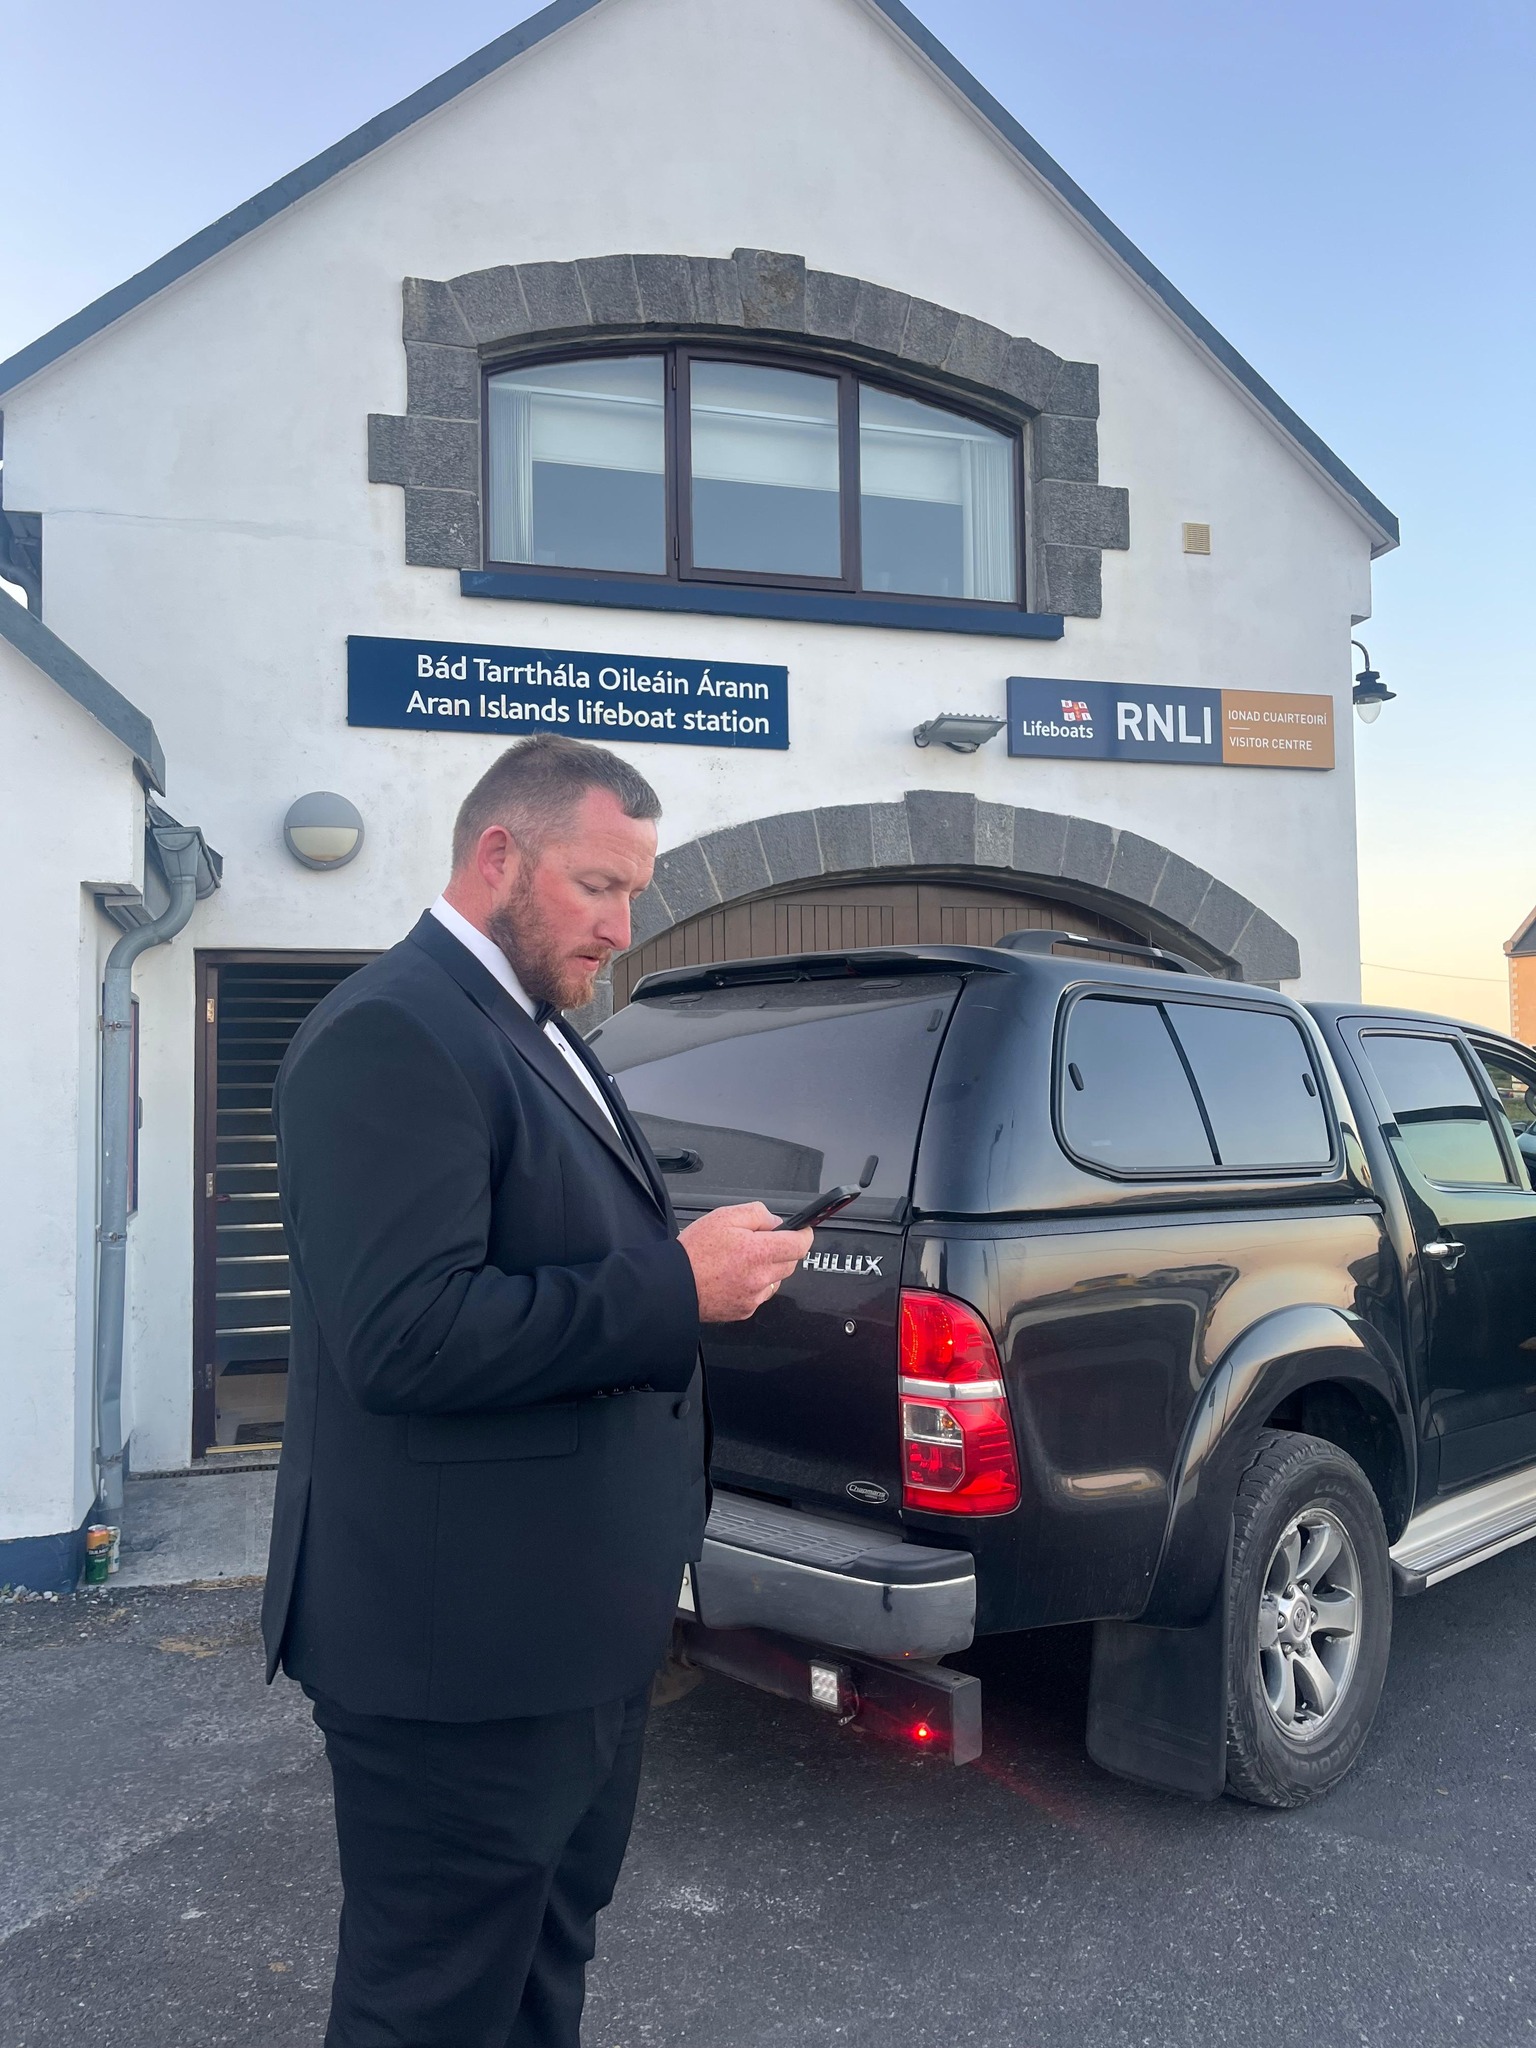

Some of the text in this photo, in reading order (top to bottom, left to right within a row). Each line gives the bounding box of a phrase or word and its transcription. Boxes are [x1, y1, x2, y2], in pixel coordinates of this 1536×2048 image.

[417, 654, 769, 700] Bád Tarrthála Oileáin Árann
[406, 690, 770, 734] Aran Islands lifeboat station
[1116, 701, 1212, 745] RNLI
[1228, 710, 1328, 725] IONAD CUAIRTEOIRÍ
[1022, 720, 1094, 739] Lifeboats
[1229, 736, 1313, 751] VISITOR CENTRE
[803, 1252, 883, 1276] HILUX
